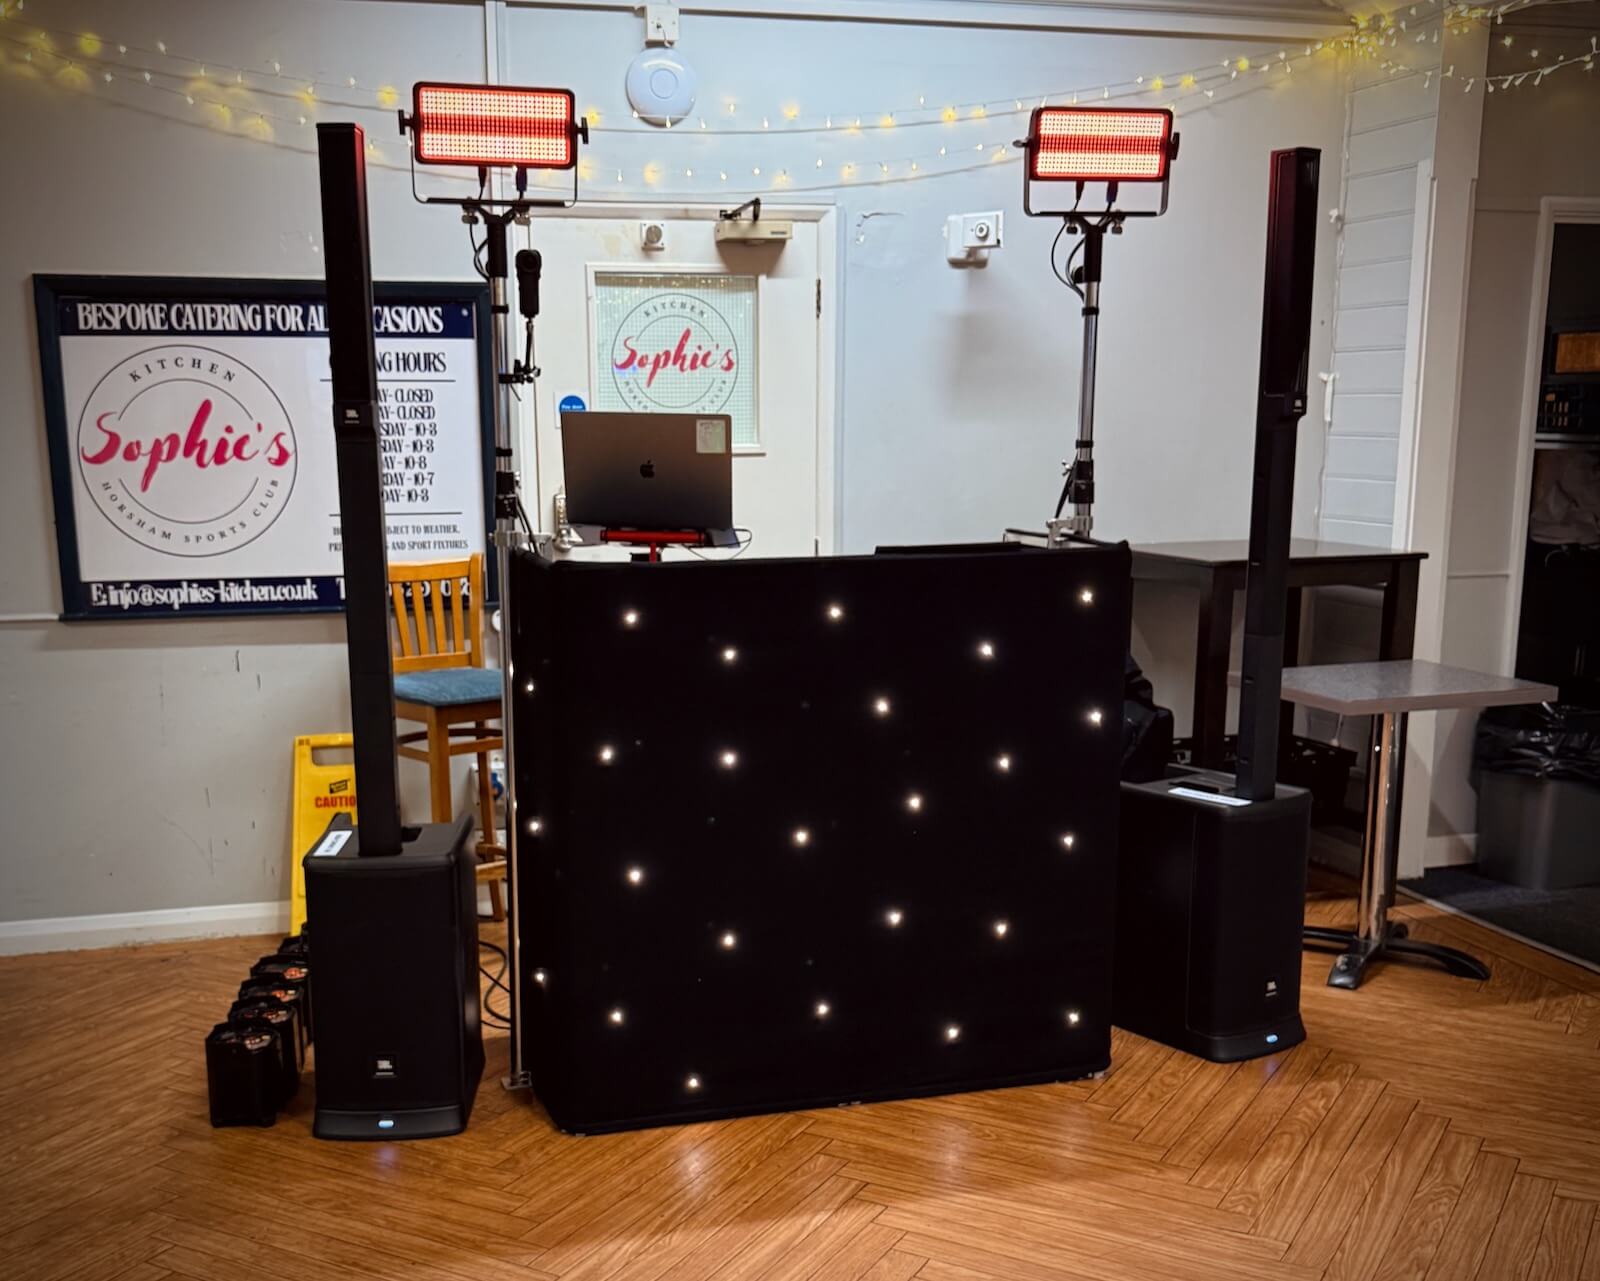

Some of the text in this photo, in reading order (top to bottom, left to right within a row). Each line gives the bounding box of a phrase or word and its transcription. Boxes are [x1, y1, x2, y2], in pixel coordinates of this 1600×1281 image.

[77, 303, 444, 333] BESPOKE CATERING FOR AL CASIONS
[396, 352, 447, 373] HOURS
[613, 327, 736, 389] Sophie's
[129, 356, 236, 383] KITCHEN
[395, 388, 434, 403] CLOSED
[397, 405, 436, 420] CLOSED
[81, 399, 293, 493] Sophie's
[101, 479, 279, 543] HORSHAM SPORTS CLUB
[412, 525, 422, 534] TO
[391, 540, 406, 551] AND
[408, 541, 432, 551] SPORT
[433, 540, 468, 550] FIXTURES
[314, 795, 356, 809] CAUTIO
